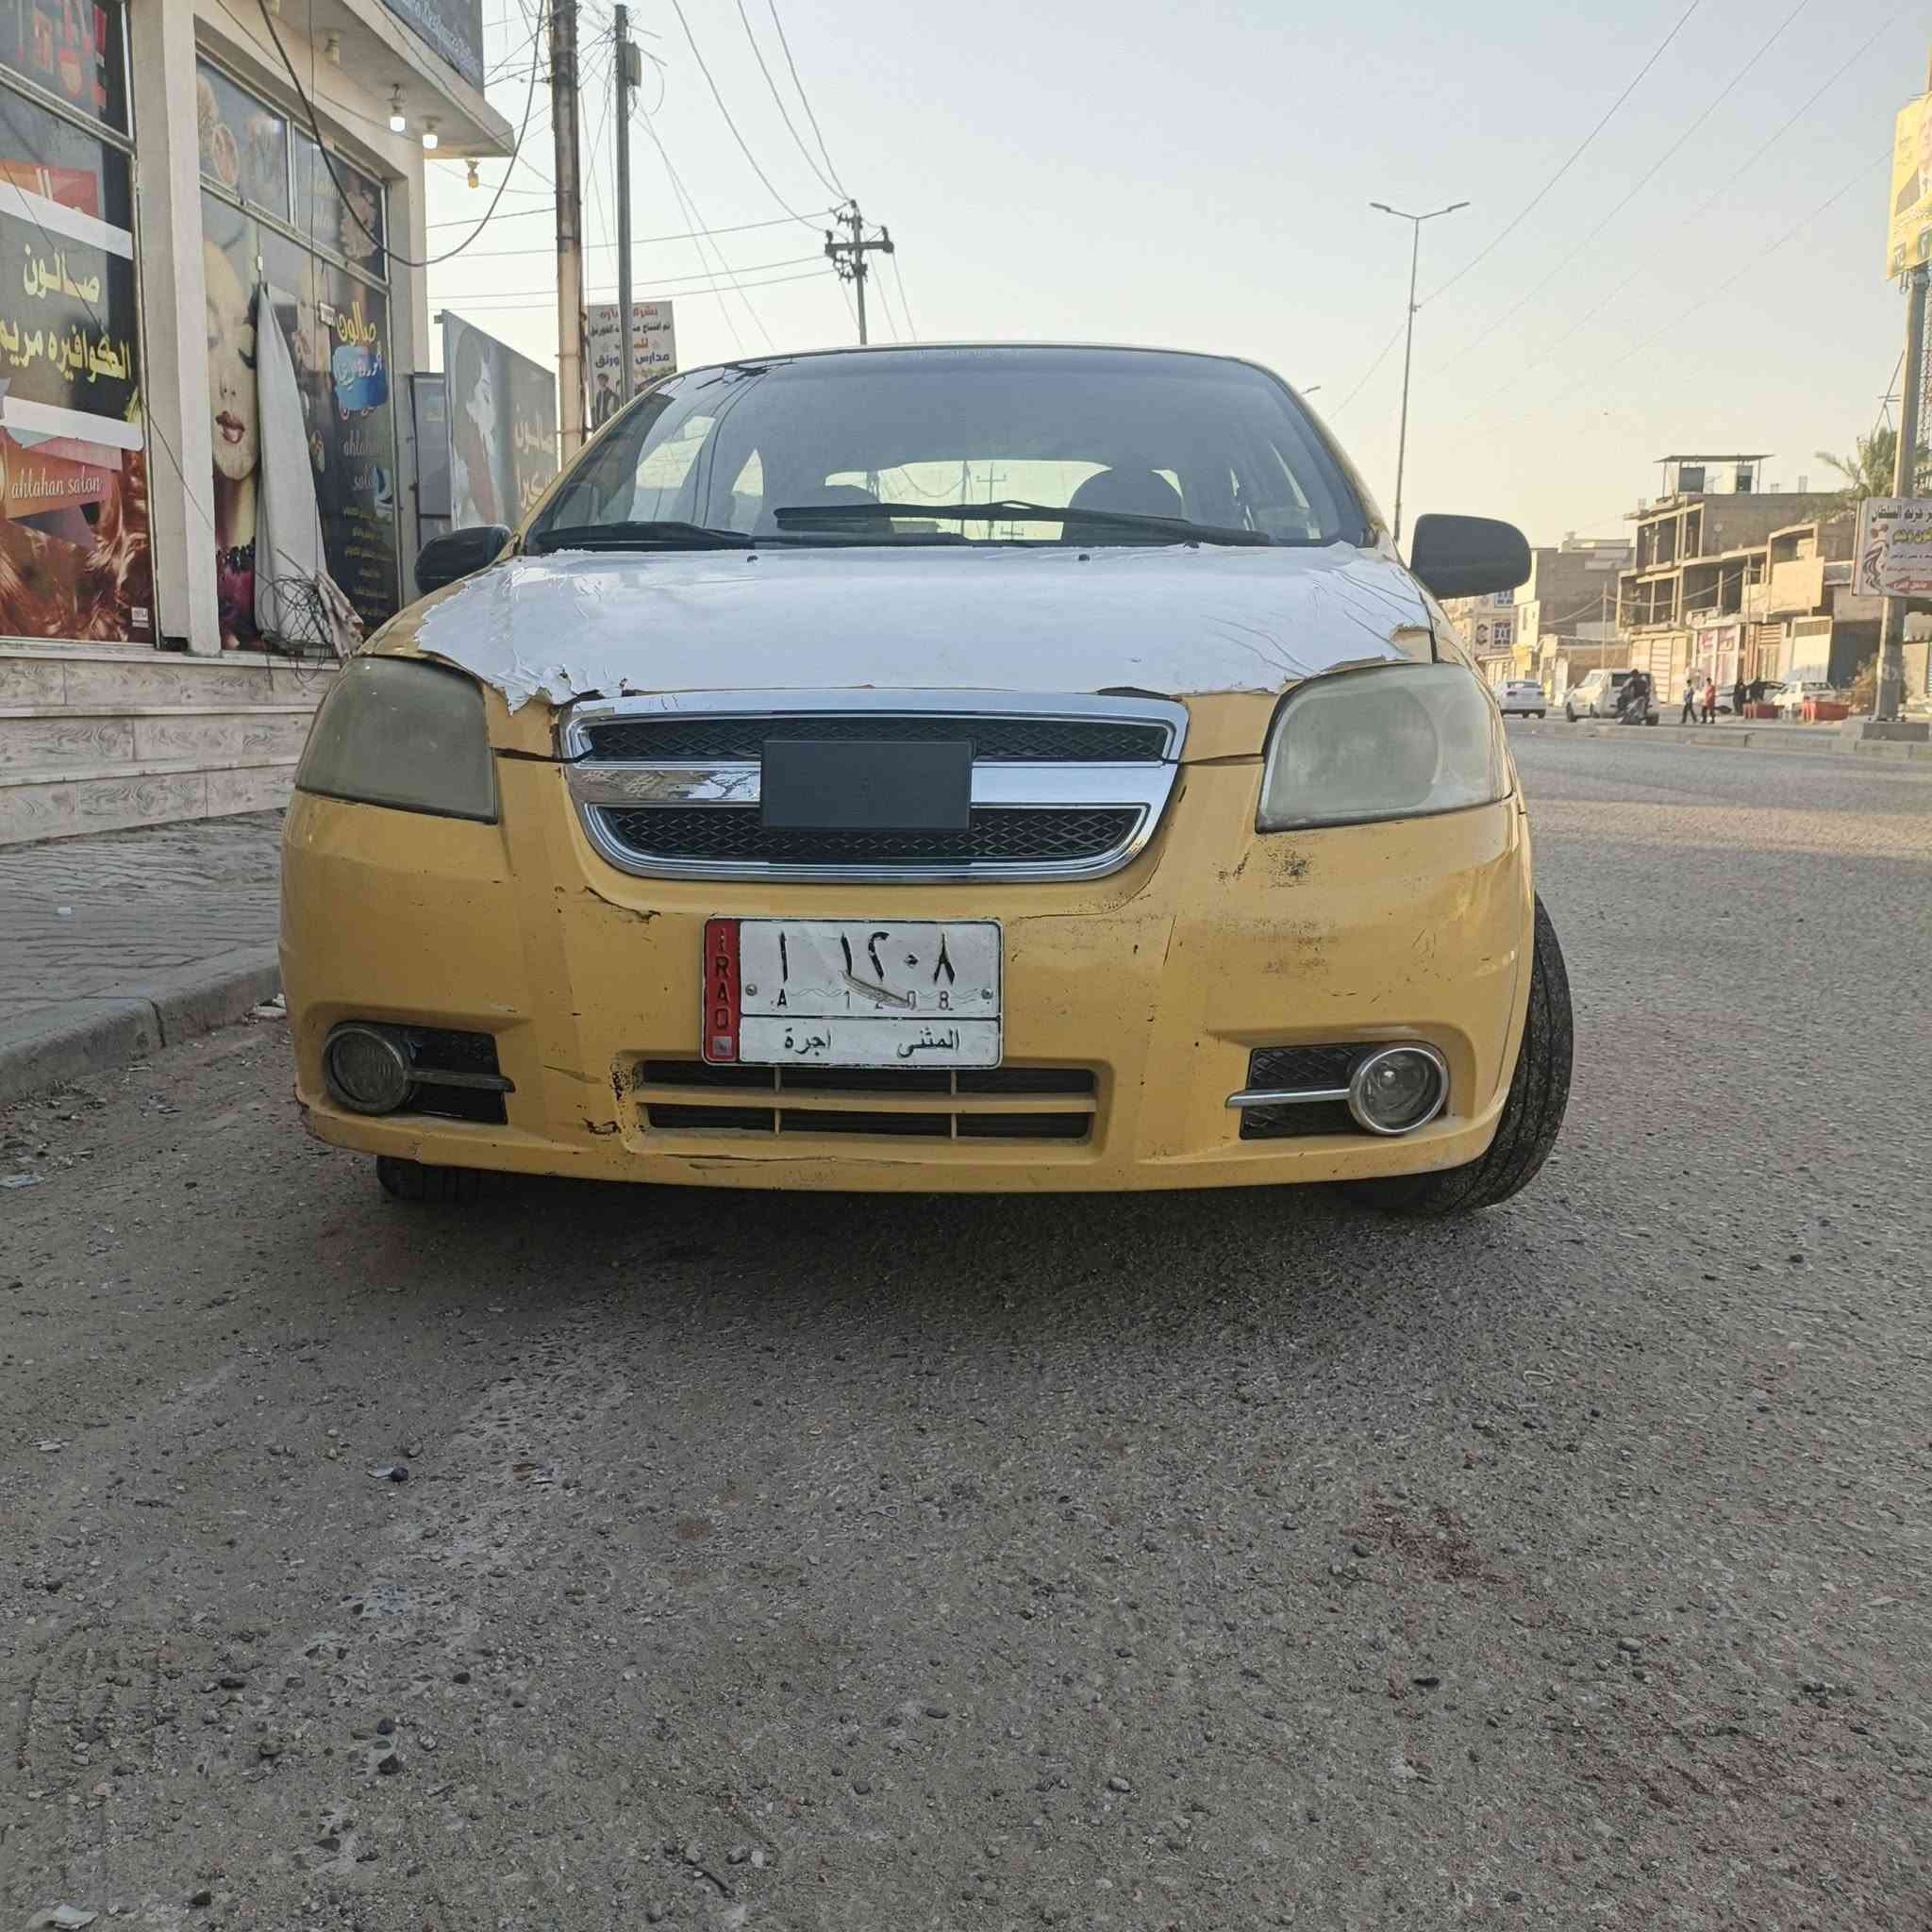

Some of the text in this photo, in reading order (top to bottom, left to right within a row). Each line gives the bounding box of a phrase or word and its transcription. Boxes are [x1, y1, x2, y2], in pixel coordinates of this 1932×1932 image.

[24, 243, 100, 303] صالون
[337, 302, 376, 345] صالون
[595, 352, 670, 368] مدارس ورنق
[68, 465, 100, 496] salon
[841, 931, 956, 985] ١٢٠٨
[776, 988, 788, 1008] A
